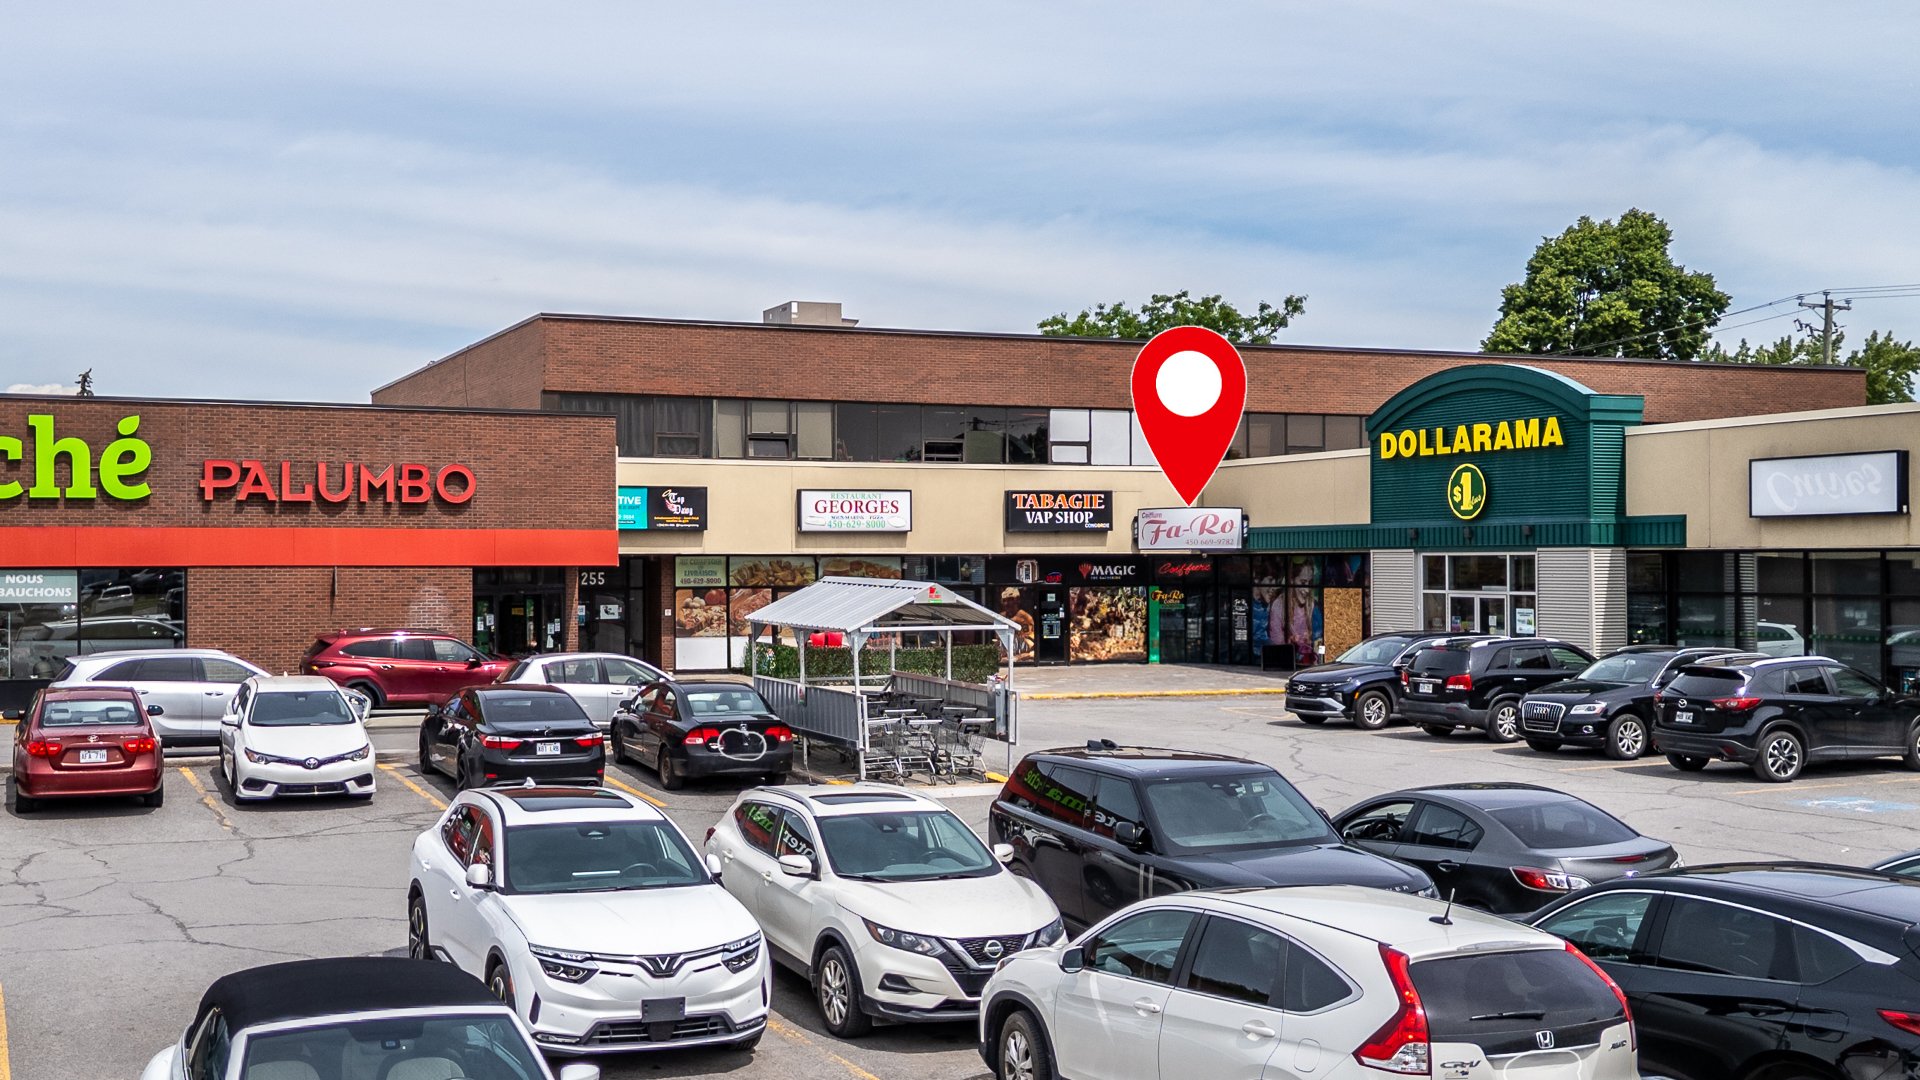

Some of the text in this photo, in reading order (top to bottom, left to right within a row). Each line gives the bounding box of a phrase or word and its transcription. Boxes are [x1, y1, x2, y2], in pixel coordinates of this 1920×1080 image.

[1380, 416, 1564, 460] DOLLARAMA
[200, 459, 477, 504] PALUMBO
[814, 499, 900, 514] GEORGES
[1012, 494, 1106, 509] TABAGIE
[827, 519, 887, 529] 450-629-8000
[1025, 511, 1094, 524] VAP SHOP
[1141, 513, 1235, 546] Fa-Ro
[1185, 537, 1234, 546] 450 669-9782
[1090, 565, 1136, 576] MAGIC
[5, 574, 44, 584] NOUS
[581, 571, 605, 585] 255
